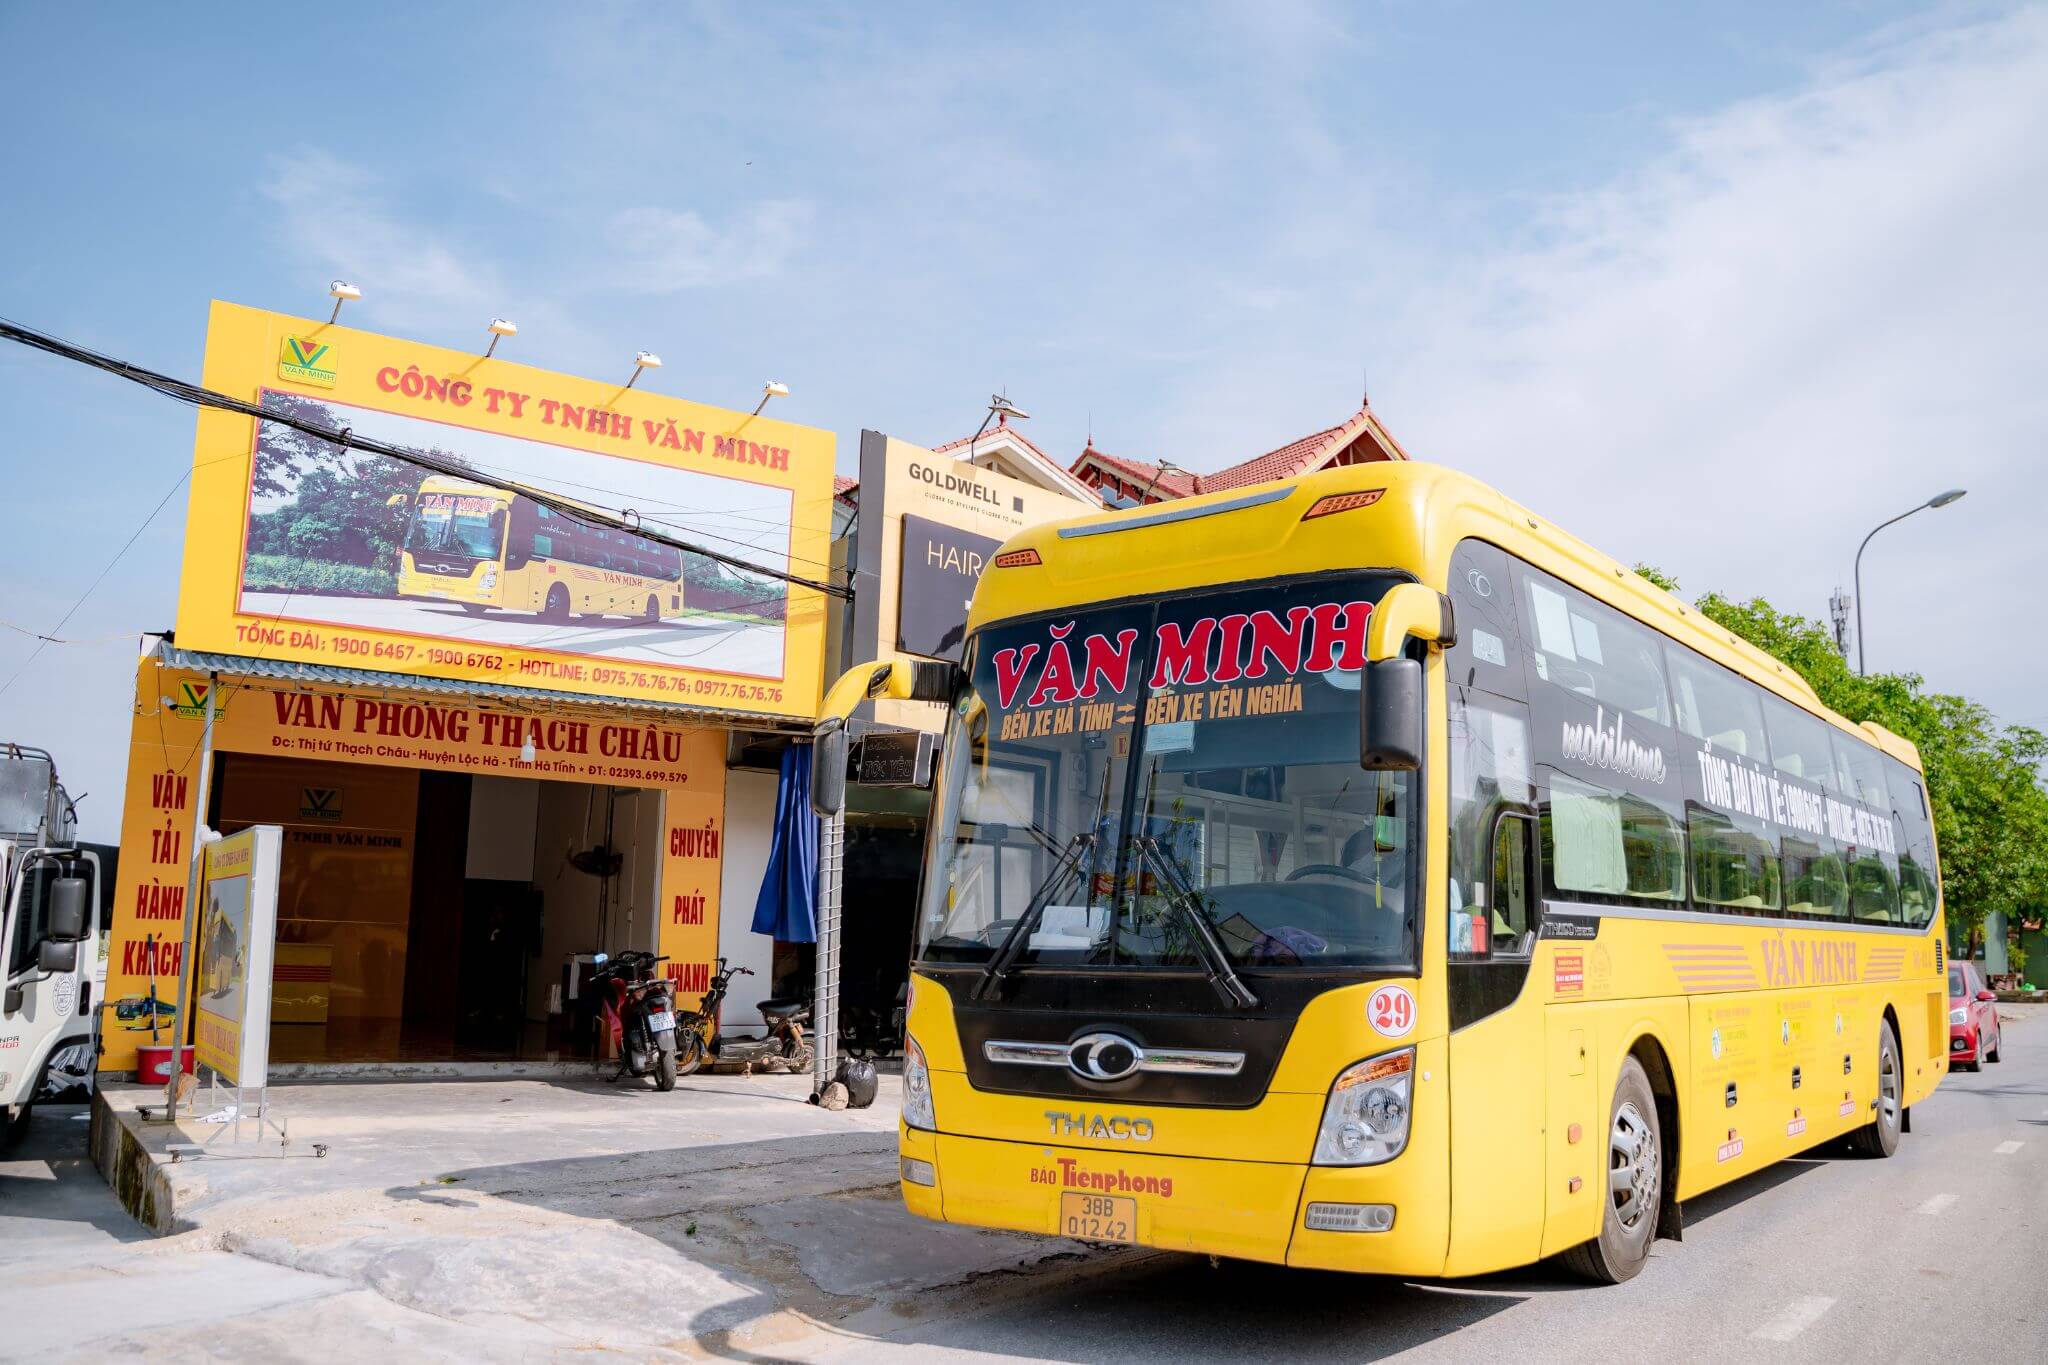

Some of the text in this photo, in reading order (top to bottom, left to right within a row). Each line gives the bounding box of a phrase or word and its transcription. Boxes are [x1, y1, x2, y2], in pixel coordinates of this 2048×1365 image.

[308, 370, 335, 382] MINH
[376, 364, 791, 472] CÔNG TY TNHH VĂN MINH
[909, 463, 1001, 507] GOLDWELL
[623, 576, 643, 588] MINH
[928, 540, 982, 579] HAIR
[236, 619, 285, 647] TỔNG
[332, 637, 371, 657] 1900
[374, 641, 416, 662] 6467
[427, 648, 464, 666] 1900
[467, 653, 503, 671] 6762
[992, 601, 1375, 709] VĂN MINH
[272, 686, 345, 731] VĂN
[600, 723, 683, 763] CHÂU
[1000, 677, 1304, 741] BẾN XE HÀ TĨNH BẾN XE YÊN NGHĨA
[298, 738, 316, 753] Thị
[336, 741, 373, 757] Thạch
[418, 749, 456, 765] Huyện
[458, 753, 480, 767] Lộc
[482, 755, 499, 767] Hà
[534, 760, 551, 772] Hà
[588, 765, 606, 776] ĐT:
[609, 767, 688, 784] 02393.699.579
[1562, 704, 1667, 785] mobihome
[152, 769, 188, 814] VẬN
[1697, 737, 1733, 810] TỔNG
[151, 818, 181, 865] TẢI
[670, 818, 719, 859] CHUYỂN
[135, 876, 184, 921] HÀNH
[673, 888, 706, 925] PHÁT
[122, 932, 182, 977] KHÁCH
[1761, 927, 1858, 987] VĂN MINH
[1375, 993, 1411, 1029] 29
[1044, 1110, 1154, 1142] THACO
[1030, 1165, 1057, 1186] BÁO
[1068, 1215, 1127, 1241] 012.42
[1081, 1196, 1114, 1218] 38B
